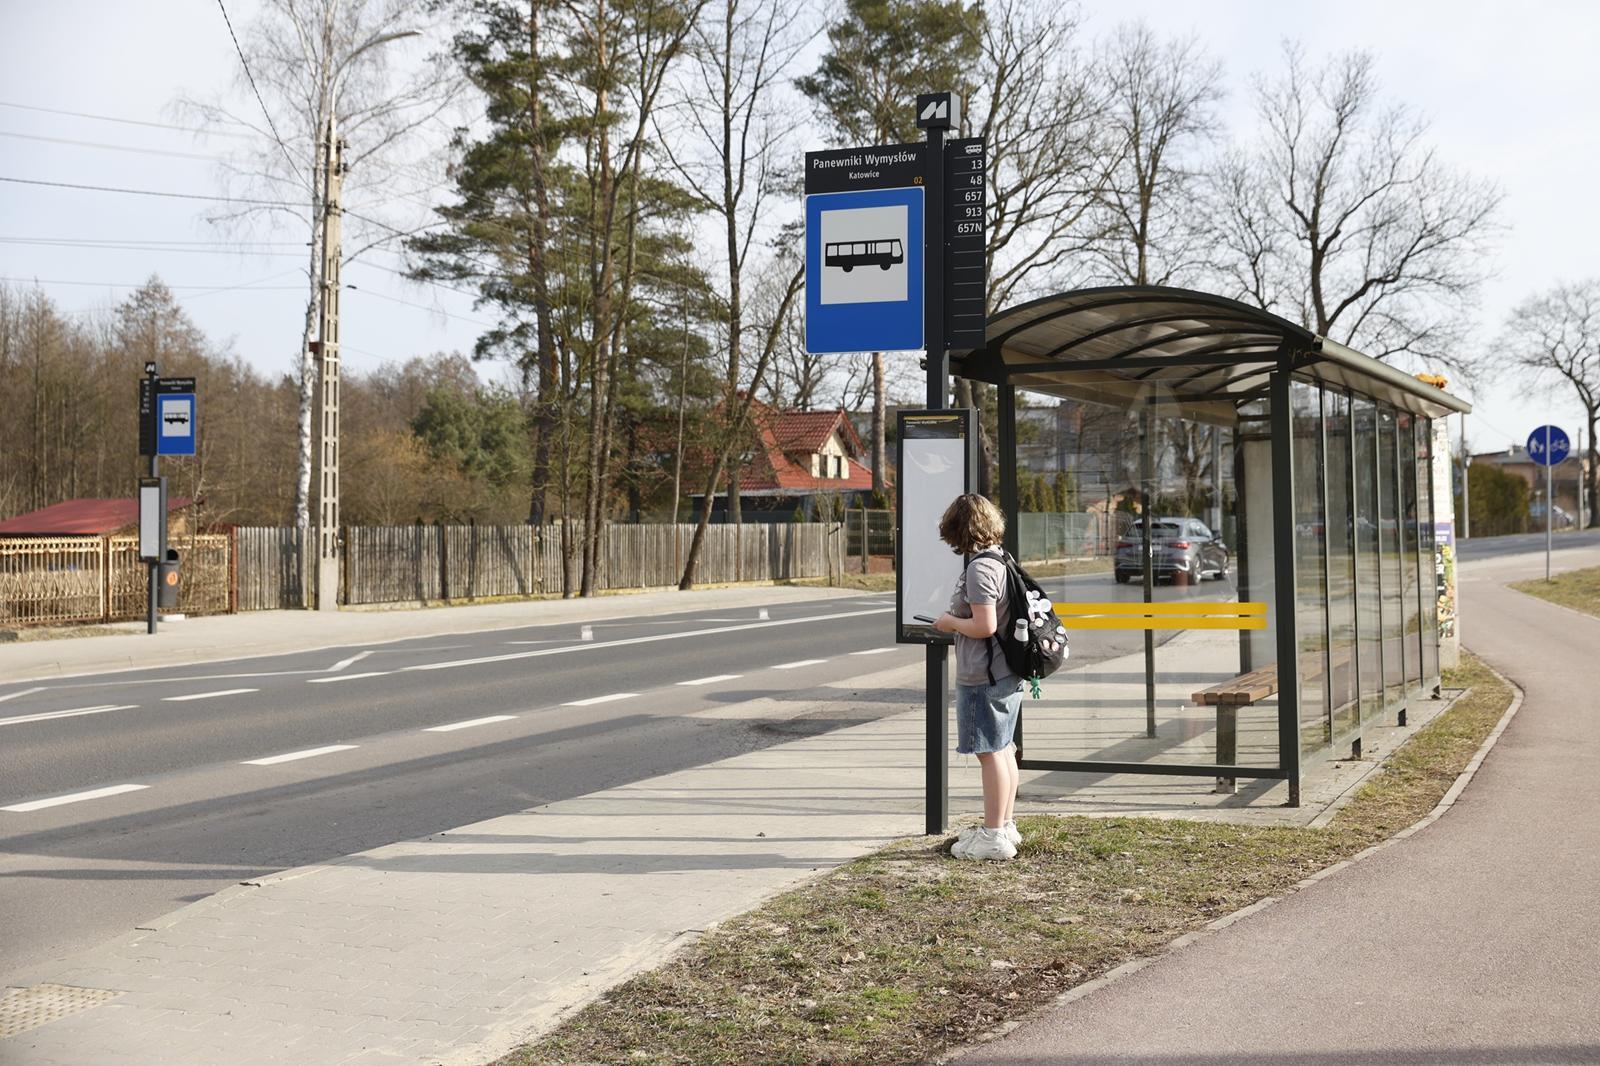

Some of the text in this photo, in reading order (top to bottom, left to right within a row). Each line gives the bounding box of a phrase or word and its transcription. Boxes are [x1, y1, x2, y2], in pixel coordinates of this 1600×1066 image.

[813, 151, 917, 169] Panewniki Wymysłów
[971, 159, 983, 170] 13
[848, 170, 880, 179] Katowice
[913, 176, 923, 184] 02
[970, 175, 983, 185] 48
[965, 191, 982, 201] 657
[965, 207, 982, 217] 913
[957, 222, 982, 233] 657N
